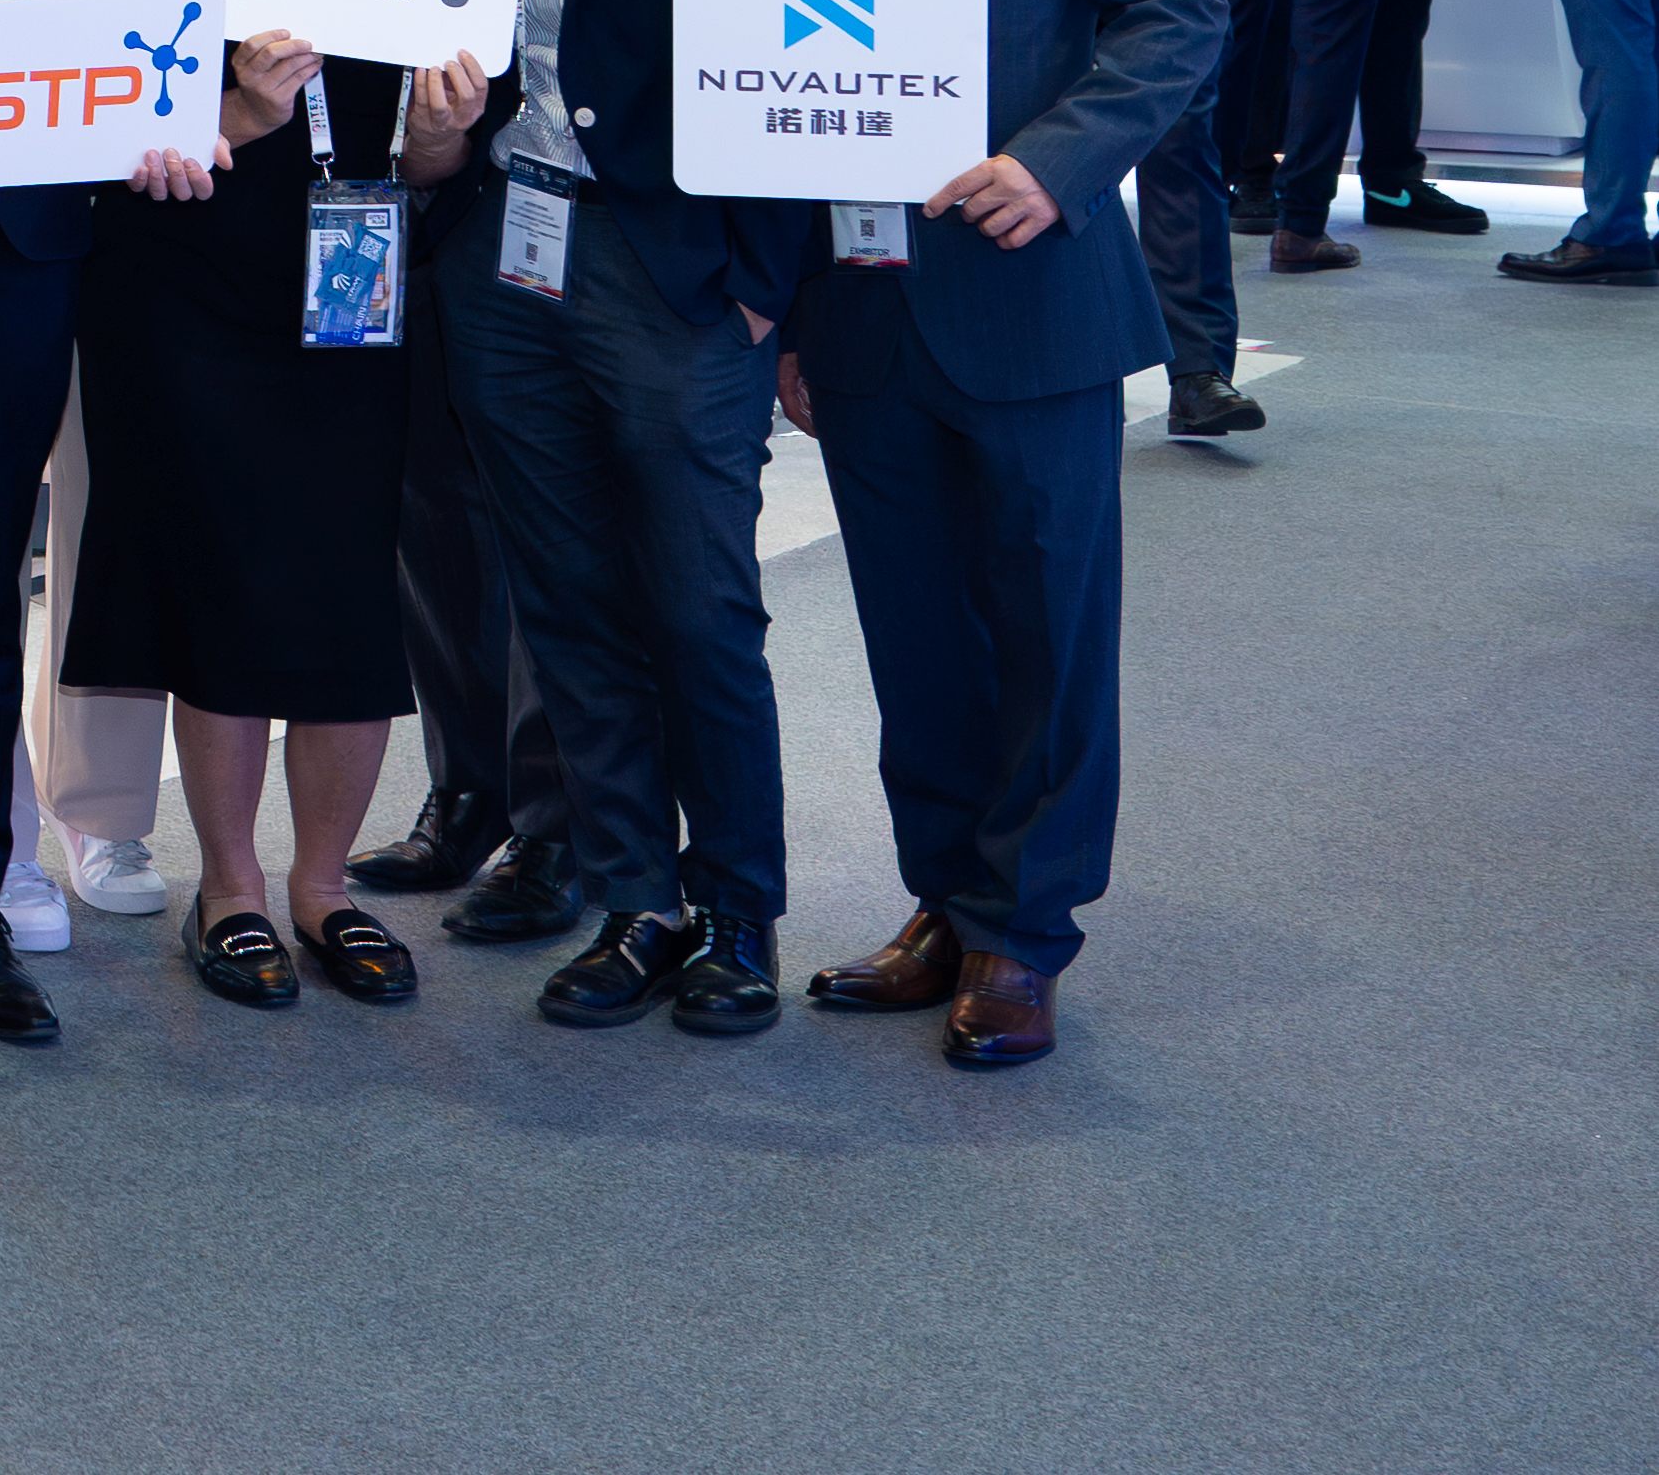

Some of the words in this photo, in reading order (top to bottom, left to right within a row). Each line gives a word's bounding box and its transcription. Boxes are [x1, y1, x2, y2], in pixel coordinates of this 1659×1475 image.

[699, 70, 960, 99] NOVAUTEK
[767, 109, 892, 137] 諾科達
